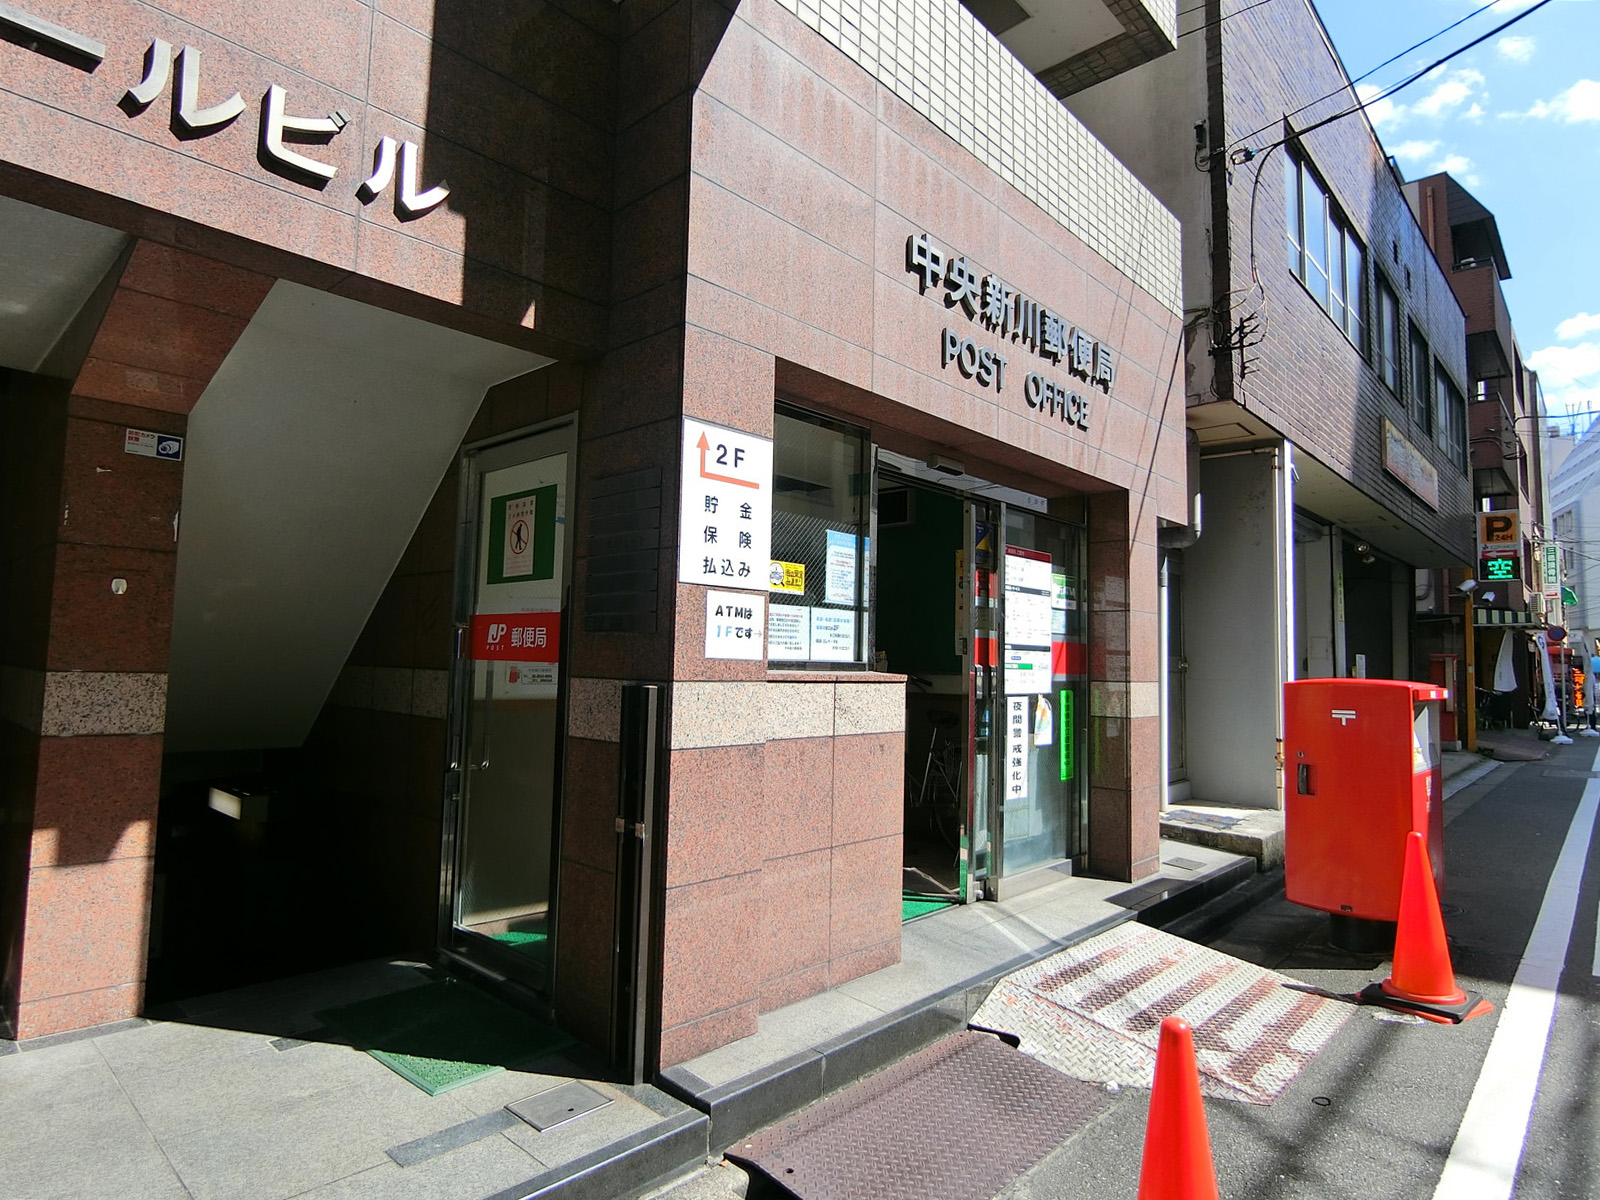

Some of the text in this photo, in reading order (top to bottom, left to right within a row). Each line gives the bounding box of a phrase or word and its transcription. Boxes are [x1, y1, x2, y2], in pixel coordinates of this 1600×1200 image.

[906, 233, 1116, 394] 中央新川郵便局
[941, 327, 1091, 431] POST OFFICE
[716, 443, 746, 468] 2F
[1486, 516, 1513, 542] P
[1494, 533, 1513, 541] 24H
[702, 555, 751, 578] 払込み
[1487, 558, 1513, 579] 空
[715, 604, 753, 620] ATMは
[510, 626, 547, 648] 郵便局
[716, 624, 753, 639] 1Fです
